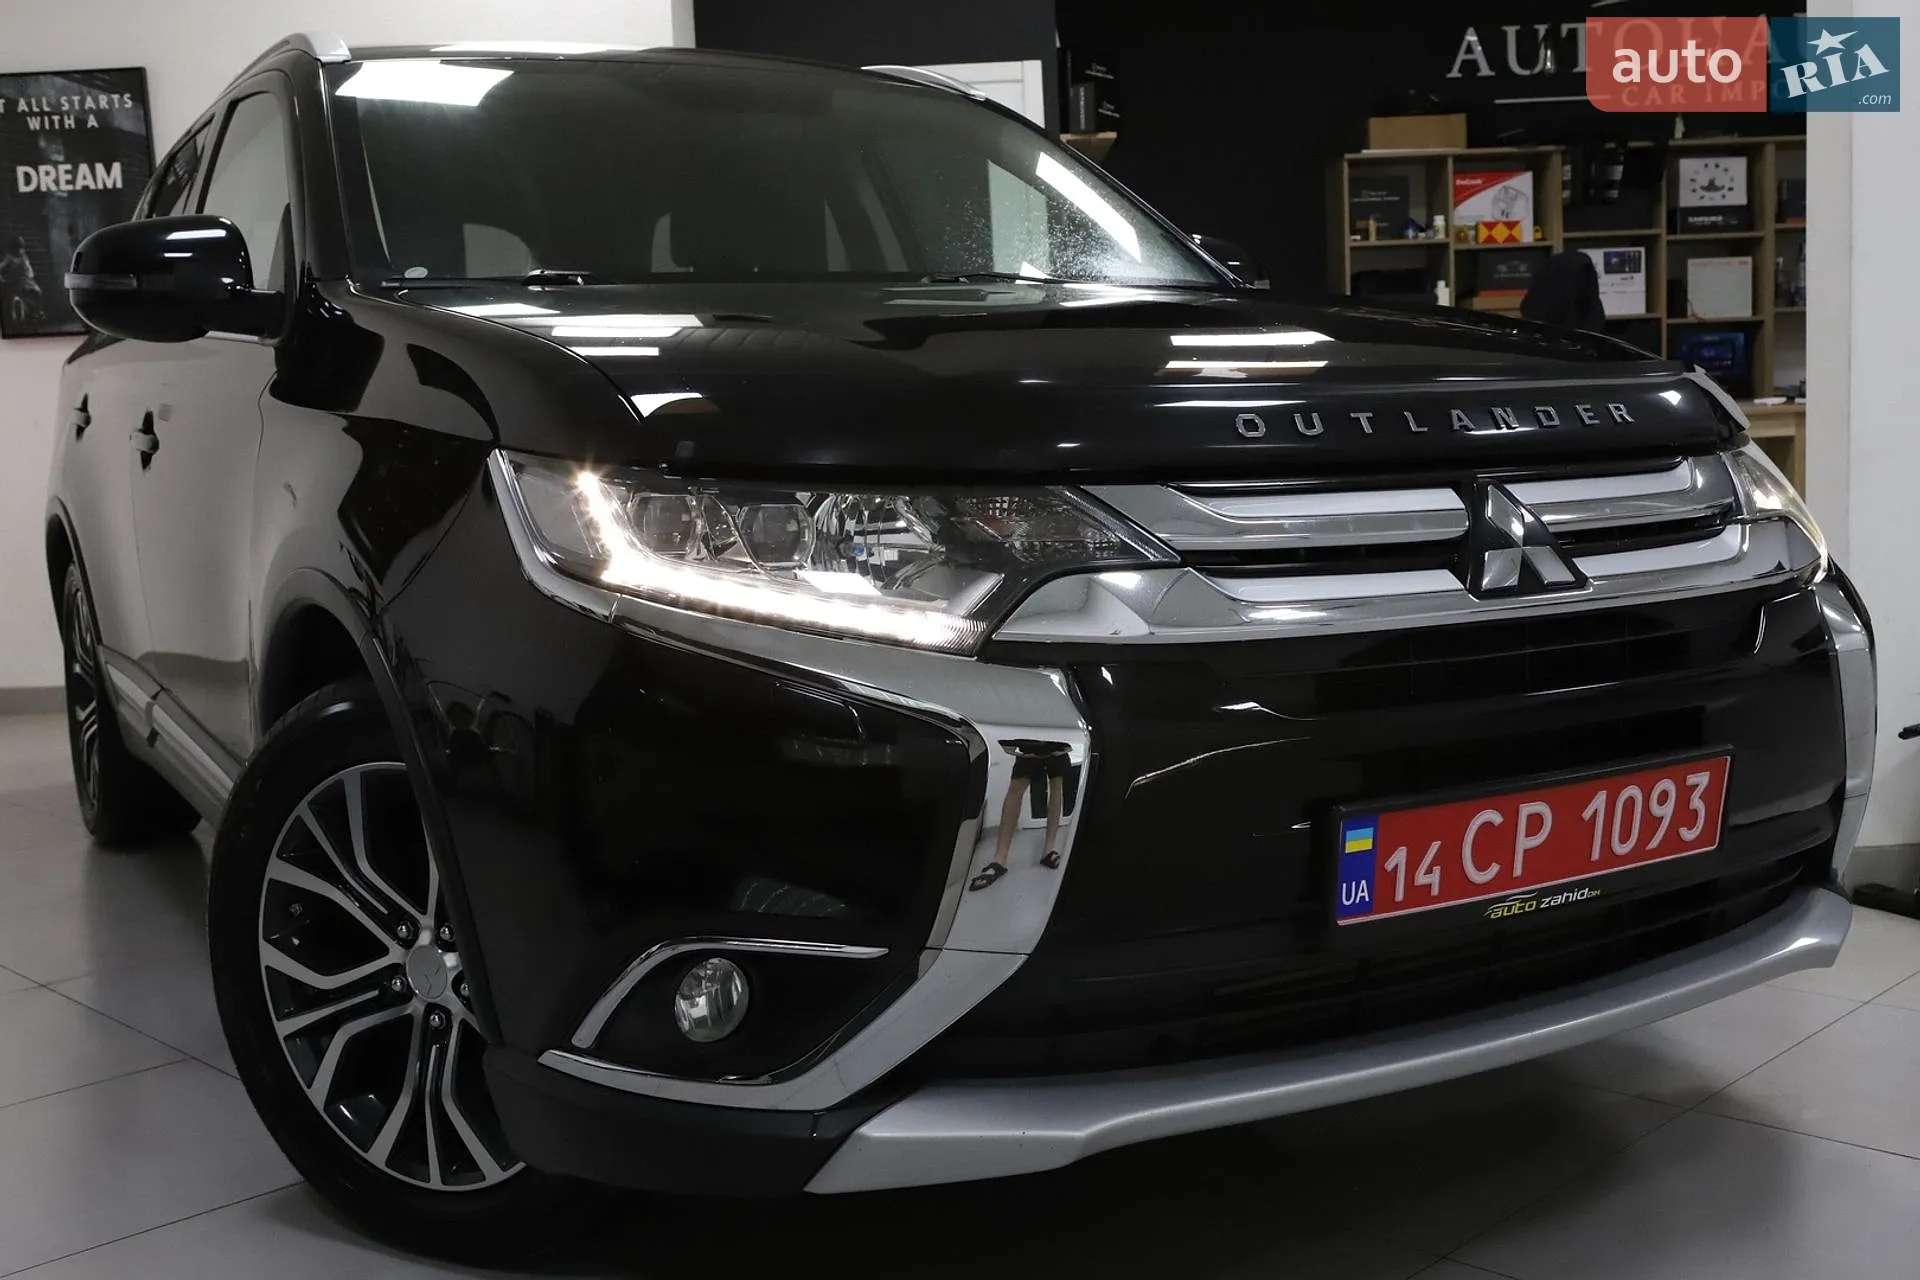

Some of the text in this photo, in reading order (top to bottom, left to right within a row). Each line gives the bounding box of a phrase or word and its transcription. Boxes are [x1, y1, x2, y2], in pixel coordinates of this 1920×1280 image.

[17, 97, 51, 113] ALL
[60, 93, 133, 111] STARTS
[1621, 83, 1687, 107] CAR
[26, 113, 99, 131] WITH A
[16, 161, 123, 193] DREAM
[1235, 402, 1636, 439] OUTLANDER
[1383, 771, 1711, 902] 14 CP 1093
[1342, 880, 1370, 906] UA
[1489, 899, 1538, 919] auto
